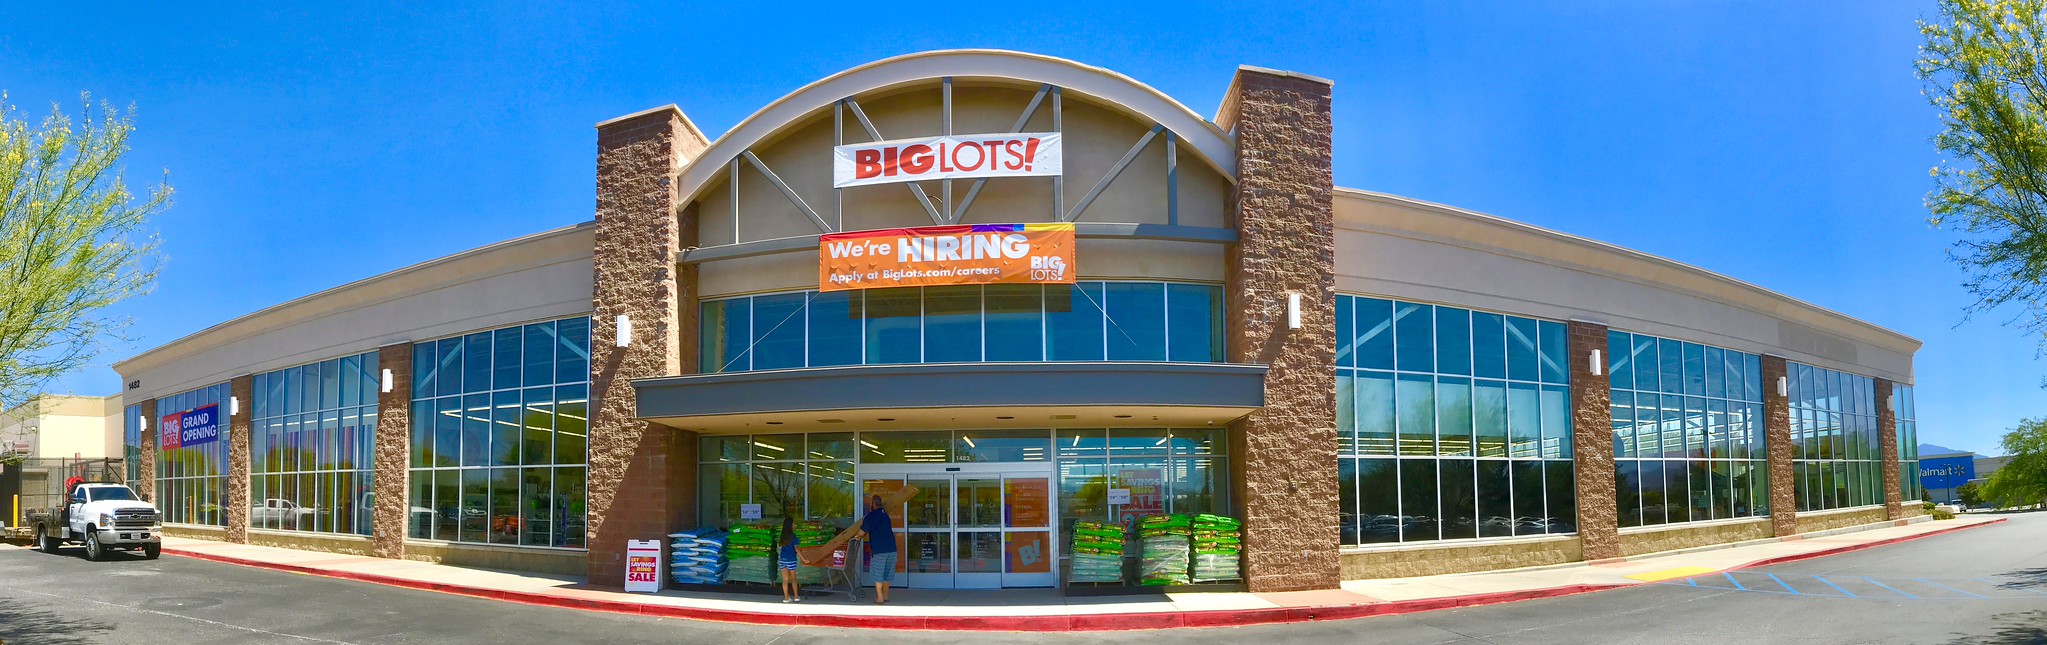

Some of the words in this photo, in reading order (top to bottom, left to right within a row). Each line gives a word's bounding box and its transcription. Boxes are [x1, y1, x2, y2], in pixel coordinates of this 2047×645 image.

[829, 240, 891, 259] We're
[898, 234, 1030, 263] HIRING
[1030, 256, 1063, 269] BIG
[829, 271, 863, 284] Apply
[867, 270, 879, 280] at
[883, 266, 1000, 280] BigLots.com/careers
[1030, 264, 1066, 281] LOTS!
[128, 380, 140, 391] 1482
[163, 420, 179, 435] BIG
[182, 412, 209, 429] GRAND
[182, 424, 216, 442] OPENING
[629, 573, 655, 581] SALE
